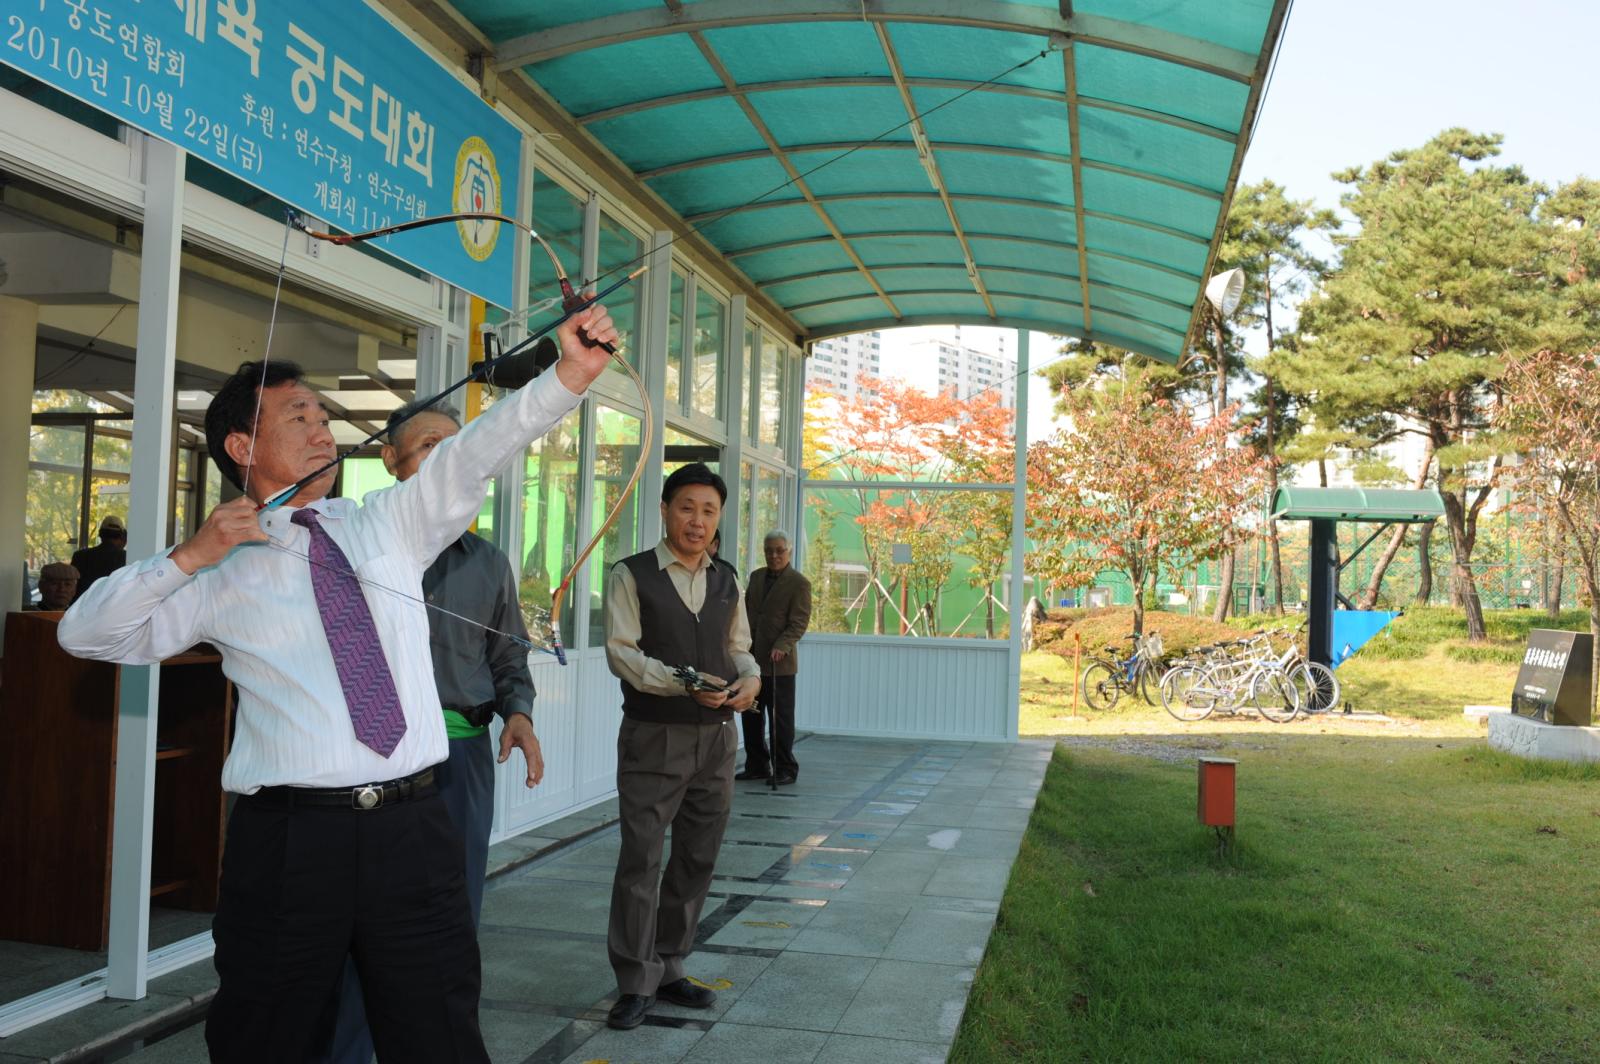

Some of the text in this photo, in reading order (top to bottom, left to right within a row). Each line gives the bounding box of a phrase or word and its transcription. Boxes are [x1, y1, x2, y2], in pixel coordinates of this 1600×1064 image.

[63, 0, 185, 88] 궁도연합회
[7, 15, 263, 174] 2010년 10월 22일(금)
[285, 21, 434, 188] 궁도대회
[294, 127, 353, 184] 연수구청
[367, 171, 427, 219] 연수구의회
[313, 181, 391, 243] 개회식 11시
